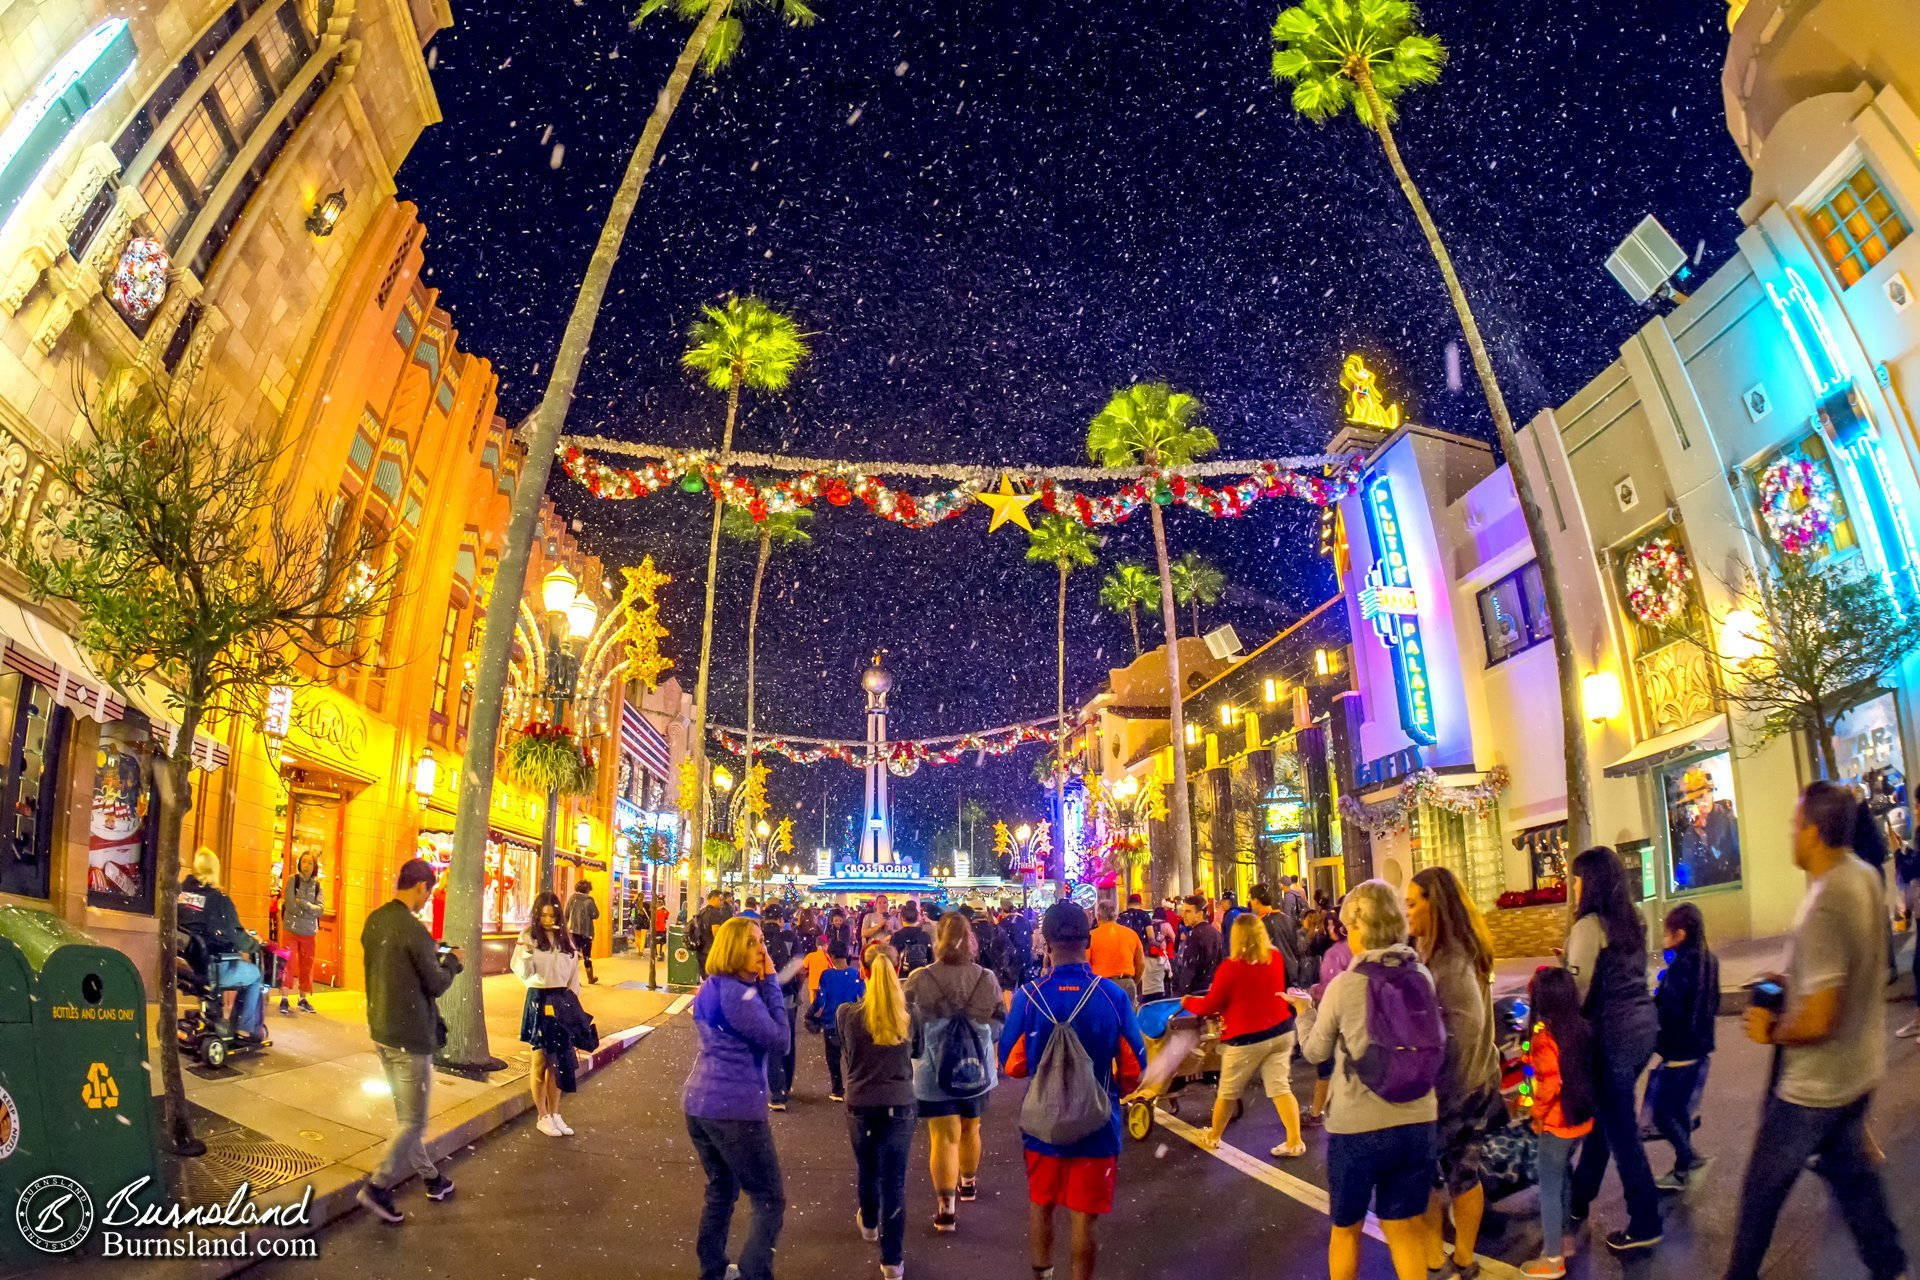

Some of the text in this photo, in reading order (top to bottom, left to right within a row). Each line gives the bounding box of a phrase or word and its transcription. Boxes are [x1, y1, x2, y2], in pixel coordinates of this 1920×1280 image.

[1402, 622, 1429, 726] PALACE
[844, 864, 913, 873] CROSSROADS
[53, 1006, 135, 1021] BOTTLES AND CANS ONLY
[5, 1127, 18, 1153] CLEAN
